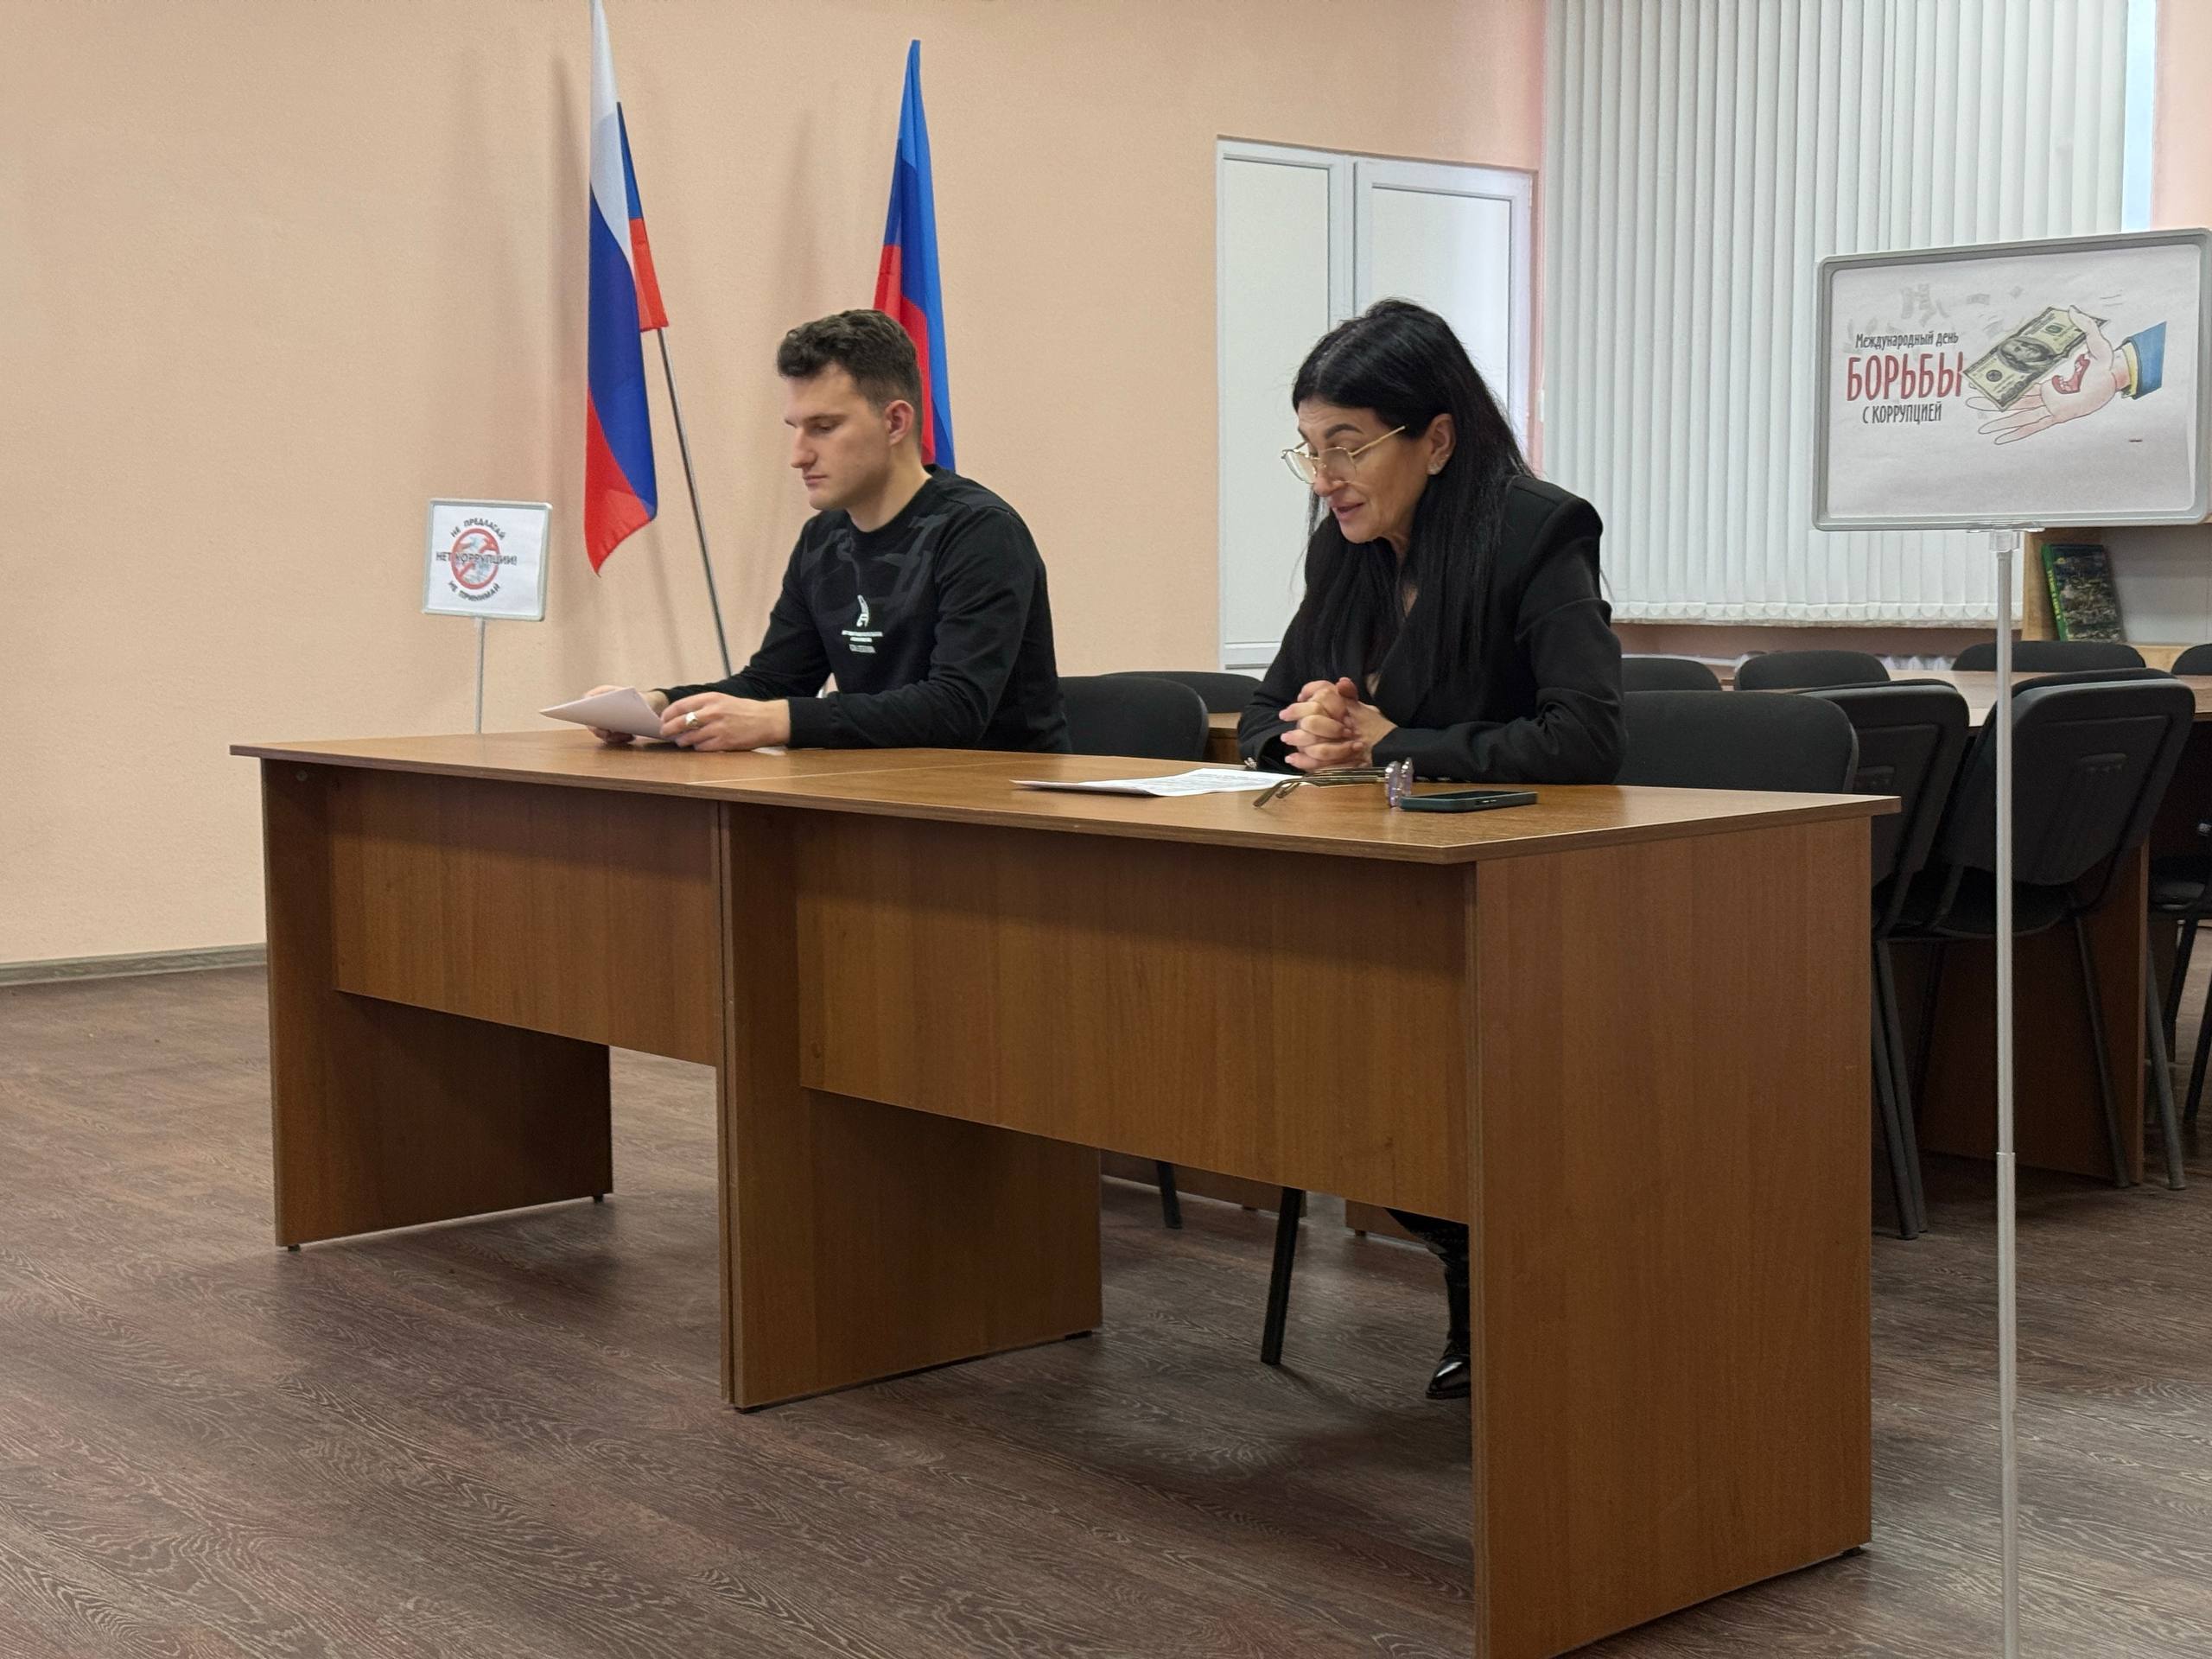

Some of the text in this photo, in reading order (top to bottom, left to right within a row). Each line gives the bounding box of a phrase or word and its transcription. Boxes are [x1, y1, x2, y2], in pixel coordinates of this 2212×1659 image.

[1855, 332, 1959, 350] Международный день
[1847, 352, 1963, 402] БОРЬБЫ
[1872, 401, 1942, 425] КОРРУПЦИЕЙ
[435, 551, 451, 562] НЕТ
